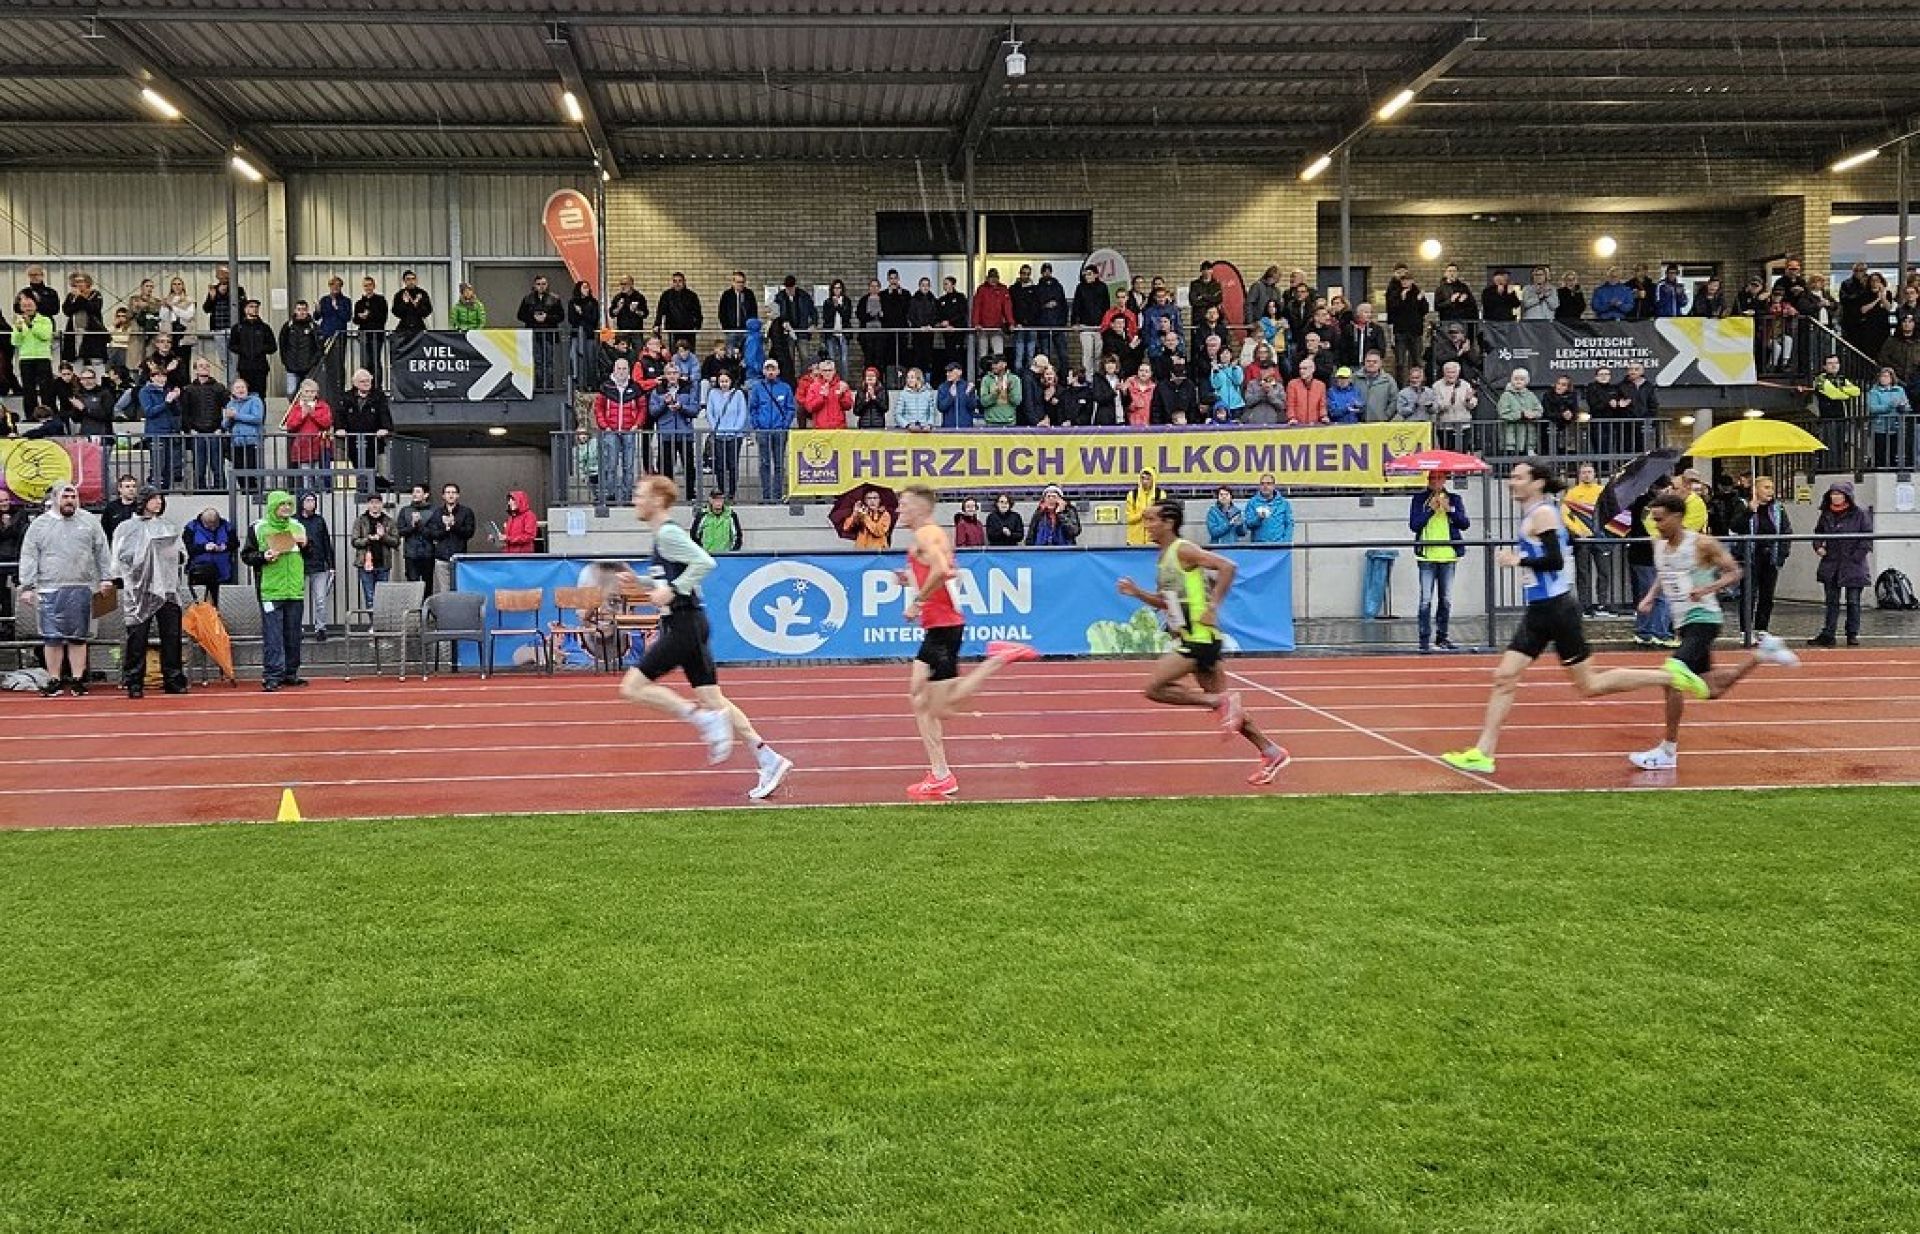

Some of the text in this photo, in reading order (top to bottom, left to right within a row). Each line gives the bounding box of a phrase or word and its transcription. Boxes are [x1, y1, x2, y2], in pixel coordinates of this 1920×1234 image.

[1574, 337, 1634, 347] DEUTSCHE
[423, 346, 455, 358] VIEL
[1555, 348, 1653, 358] LEICHTATHLETIK-
[409, 359, 470, 372] ERFOLG!
[852, 443, 1369, 478] HERZLICH WILLKOMMEN
[863, 625, 1033, 643] INTERIONAL
